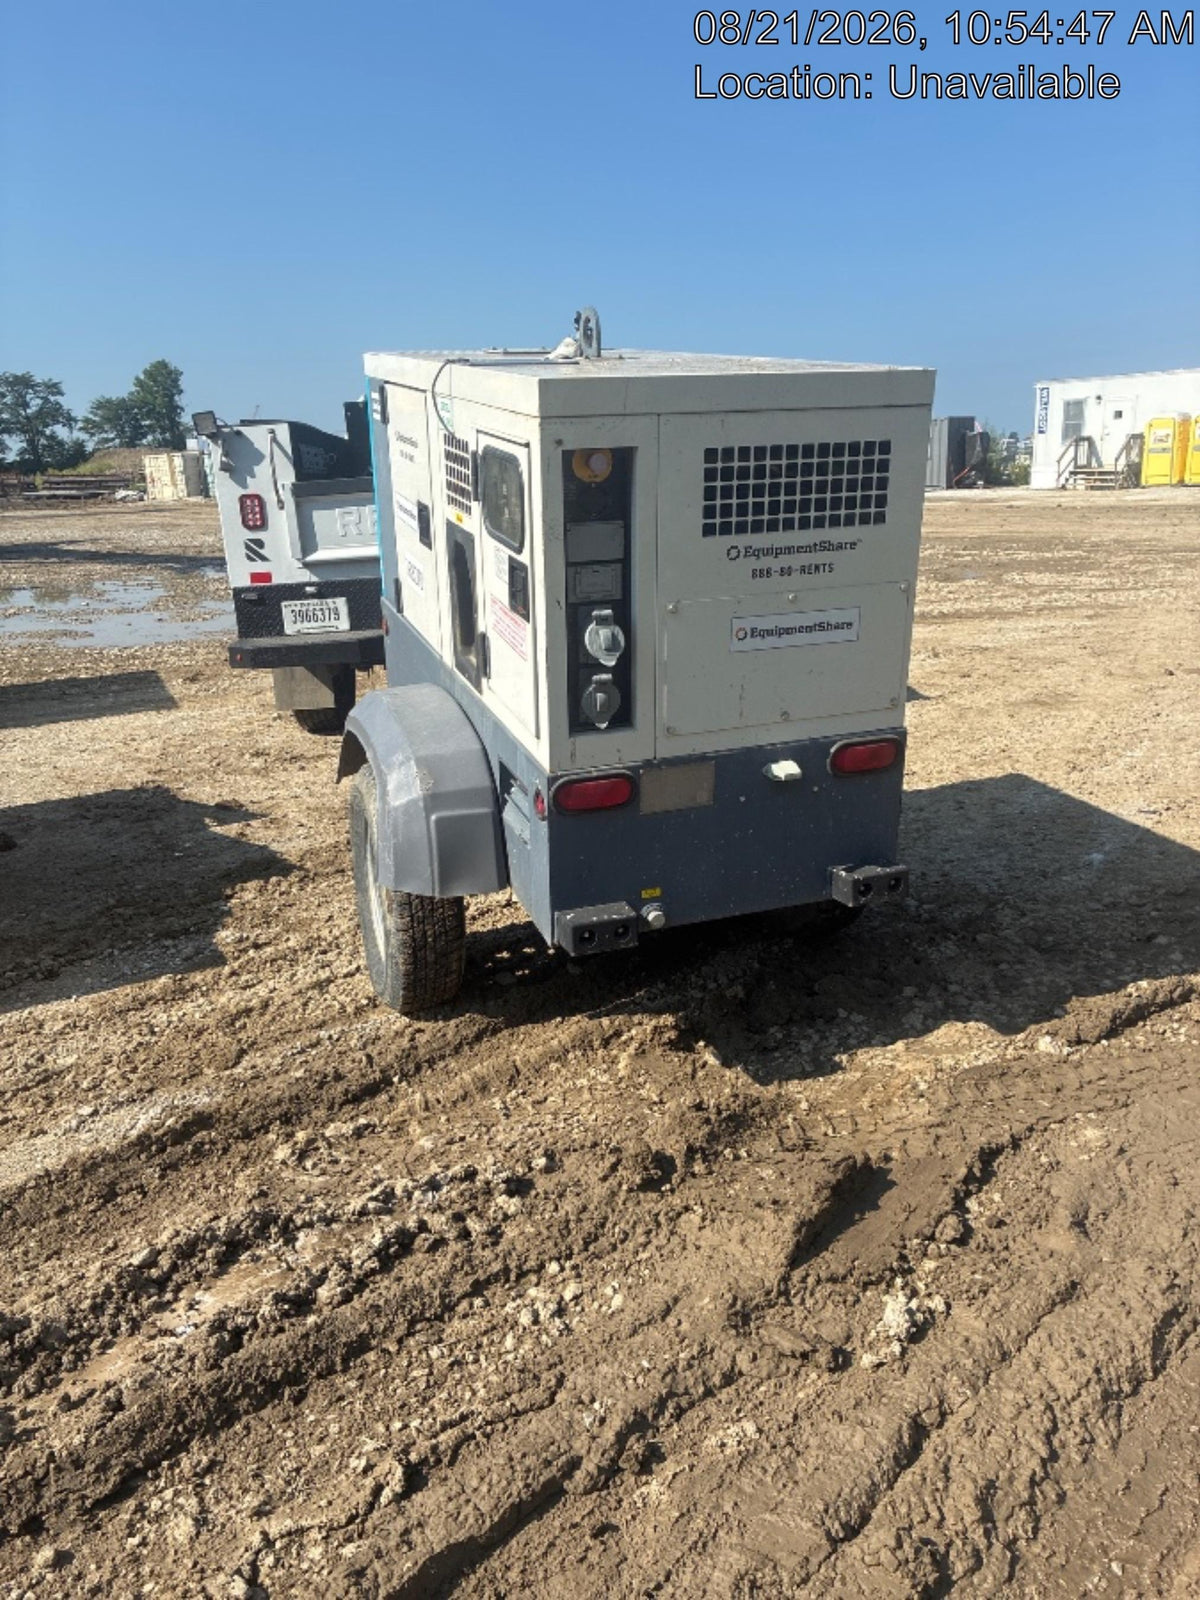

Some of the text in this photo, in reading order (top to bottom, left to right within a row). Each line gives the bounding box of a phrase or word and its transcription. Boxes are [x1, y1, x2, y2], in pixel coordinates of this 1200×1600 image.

[743, 541, 857, 560] EquipmentShare
[291, 606, 340, 625] 3966379
[750, 622, 854, 639] EquipmentShare
